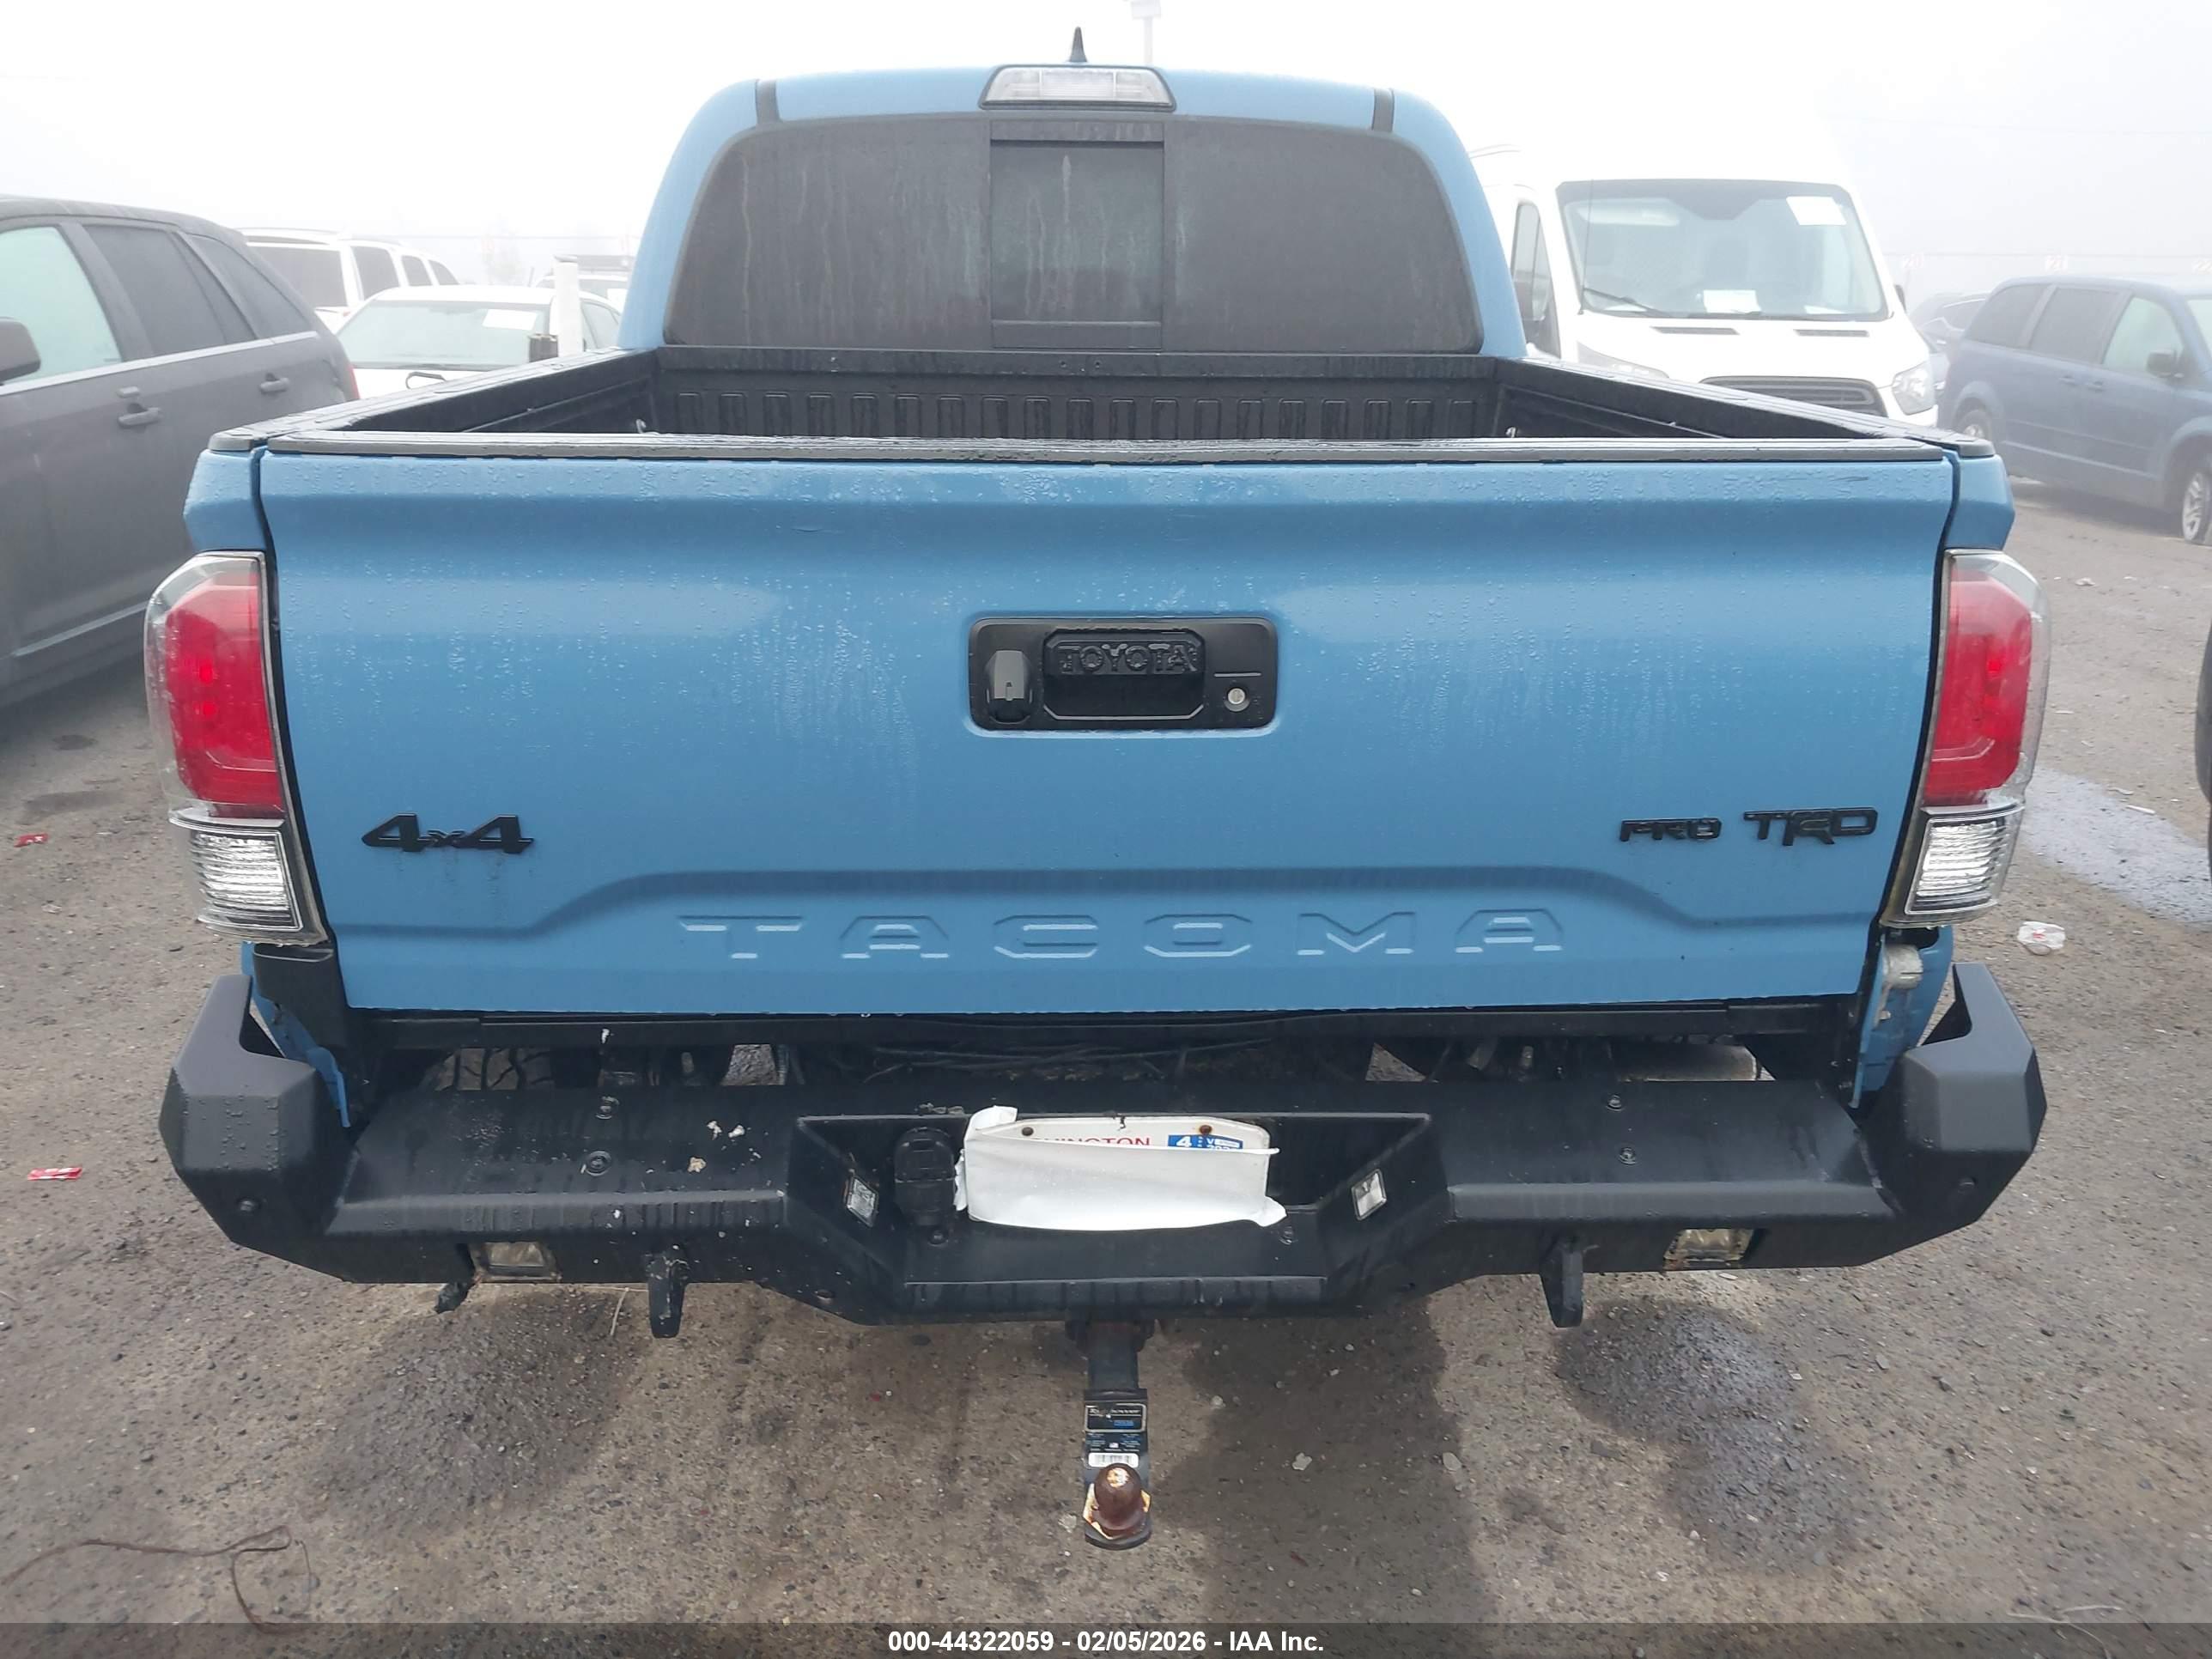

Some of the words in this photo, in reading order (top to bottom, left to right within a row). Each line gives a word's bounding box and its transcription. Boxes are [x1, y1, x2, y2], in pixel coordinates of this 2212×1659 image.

[1058, 643, 1198, 672] TOYOTA
[1620, 817, 1722, 842] PRO
[1743, 806, 1879, 846] TRD
[678, 909, 1562, 959] TACOMA
